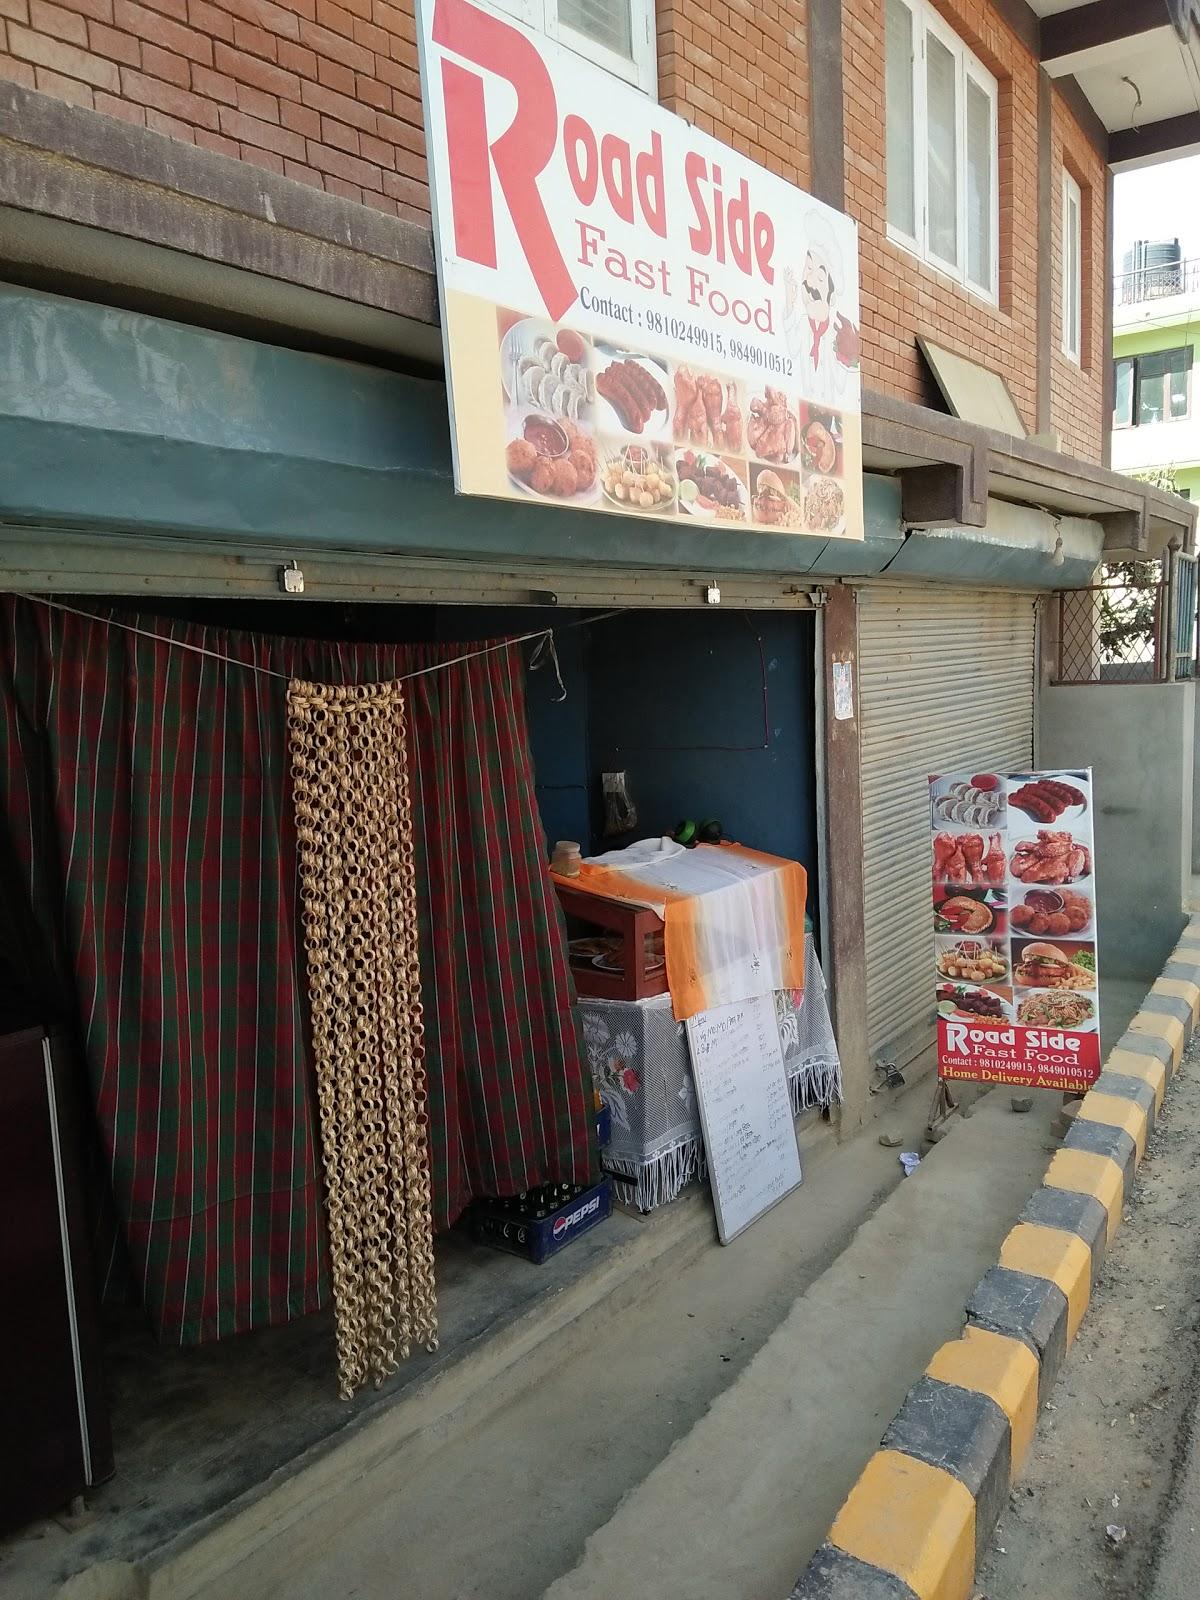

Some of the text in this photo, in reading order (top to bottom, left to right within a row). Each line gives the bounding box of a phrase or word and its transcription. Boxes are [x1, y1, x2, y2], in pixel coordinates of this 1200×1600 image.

[432, 0, 775, 322] Road Side
[575, 218, 775, 335] Fast Food
[580, 286, 634, 325] Contact
[646, 309, 727, 358] 9810249915,
[730, 339, 793, 377] 9849010512
[946, 1023, 1081, 1056] Road Side
[972, 1044, 1080, 1065] Fast Food
[942, 1055, 972, 1067] Contact
[1038, 1064, 1094, 1079] 9849010512
[943, 1066, 978, 1080] Home
[981, 1070, 1033, 1087] Delivery
[564, 1195, 600, 1231] PEPSI
